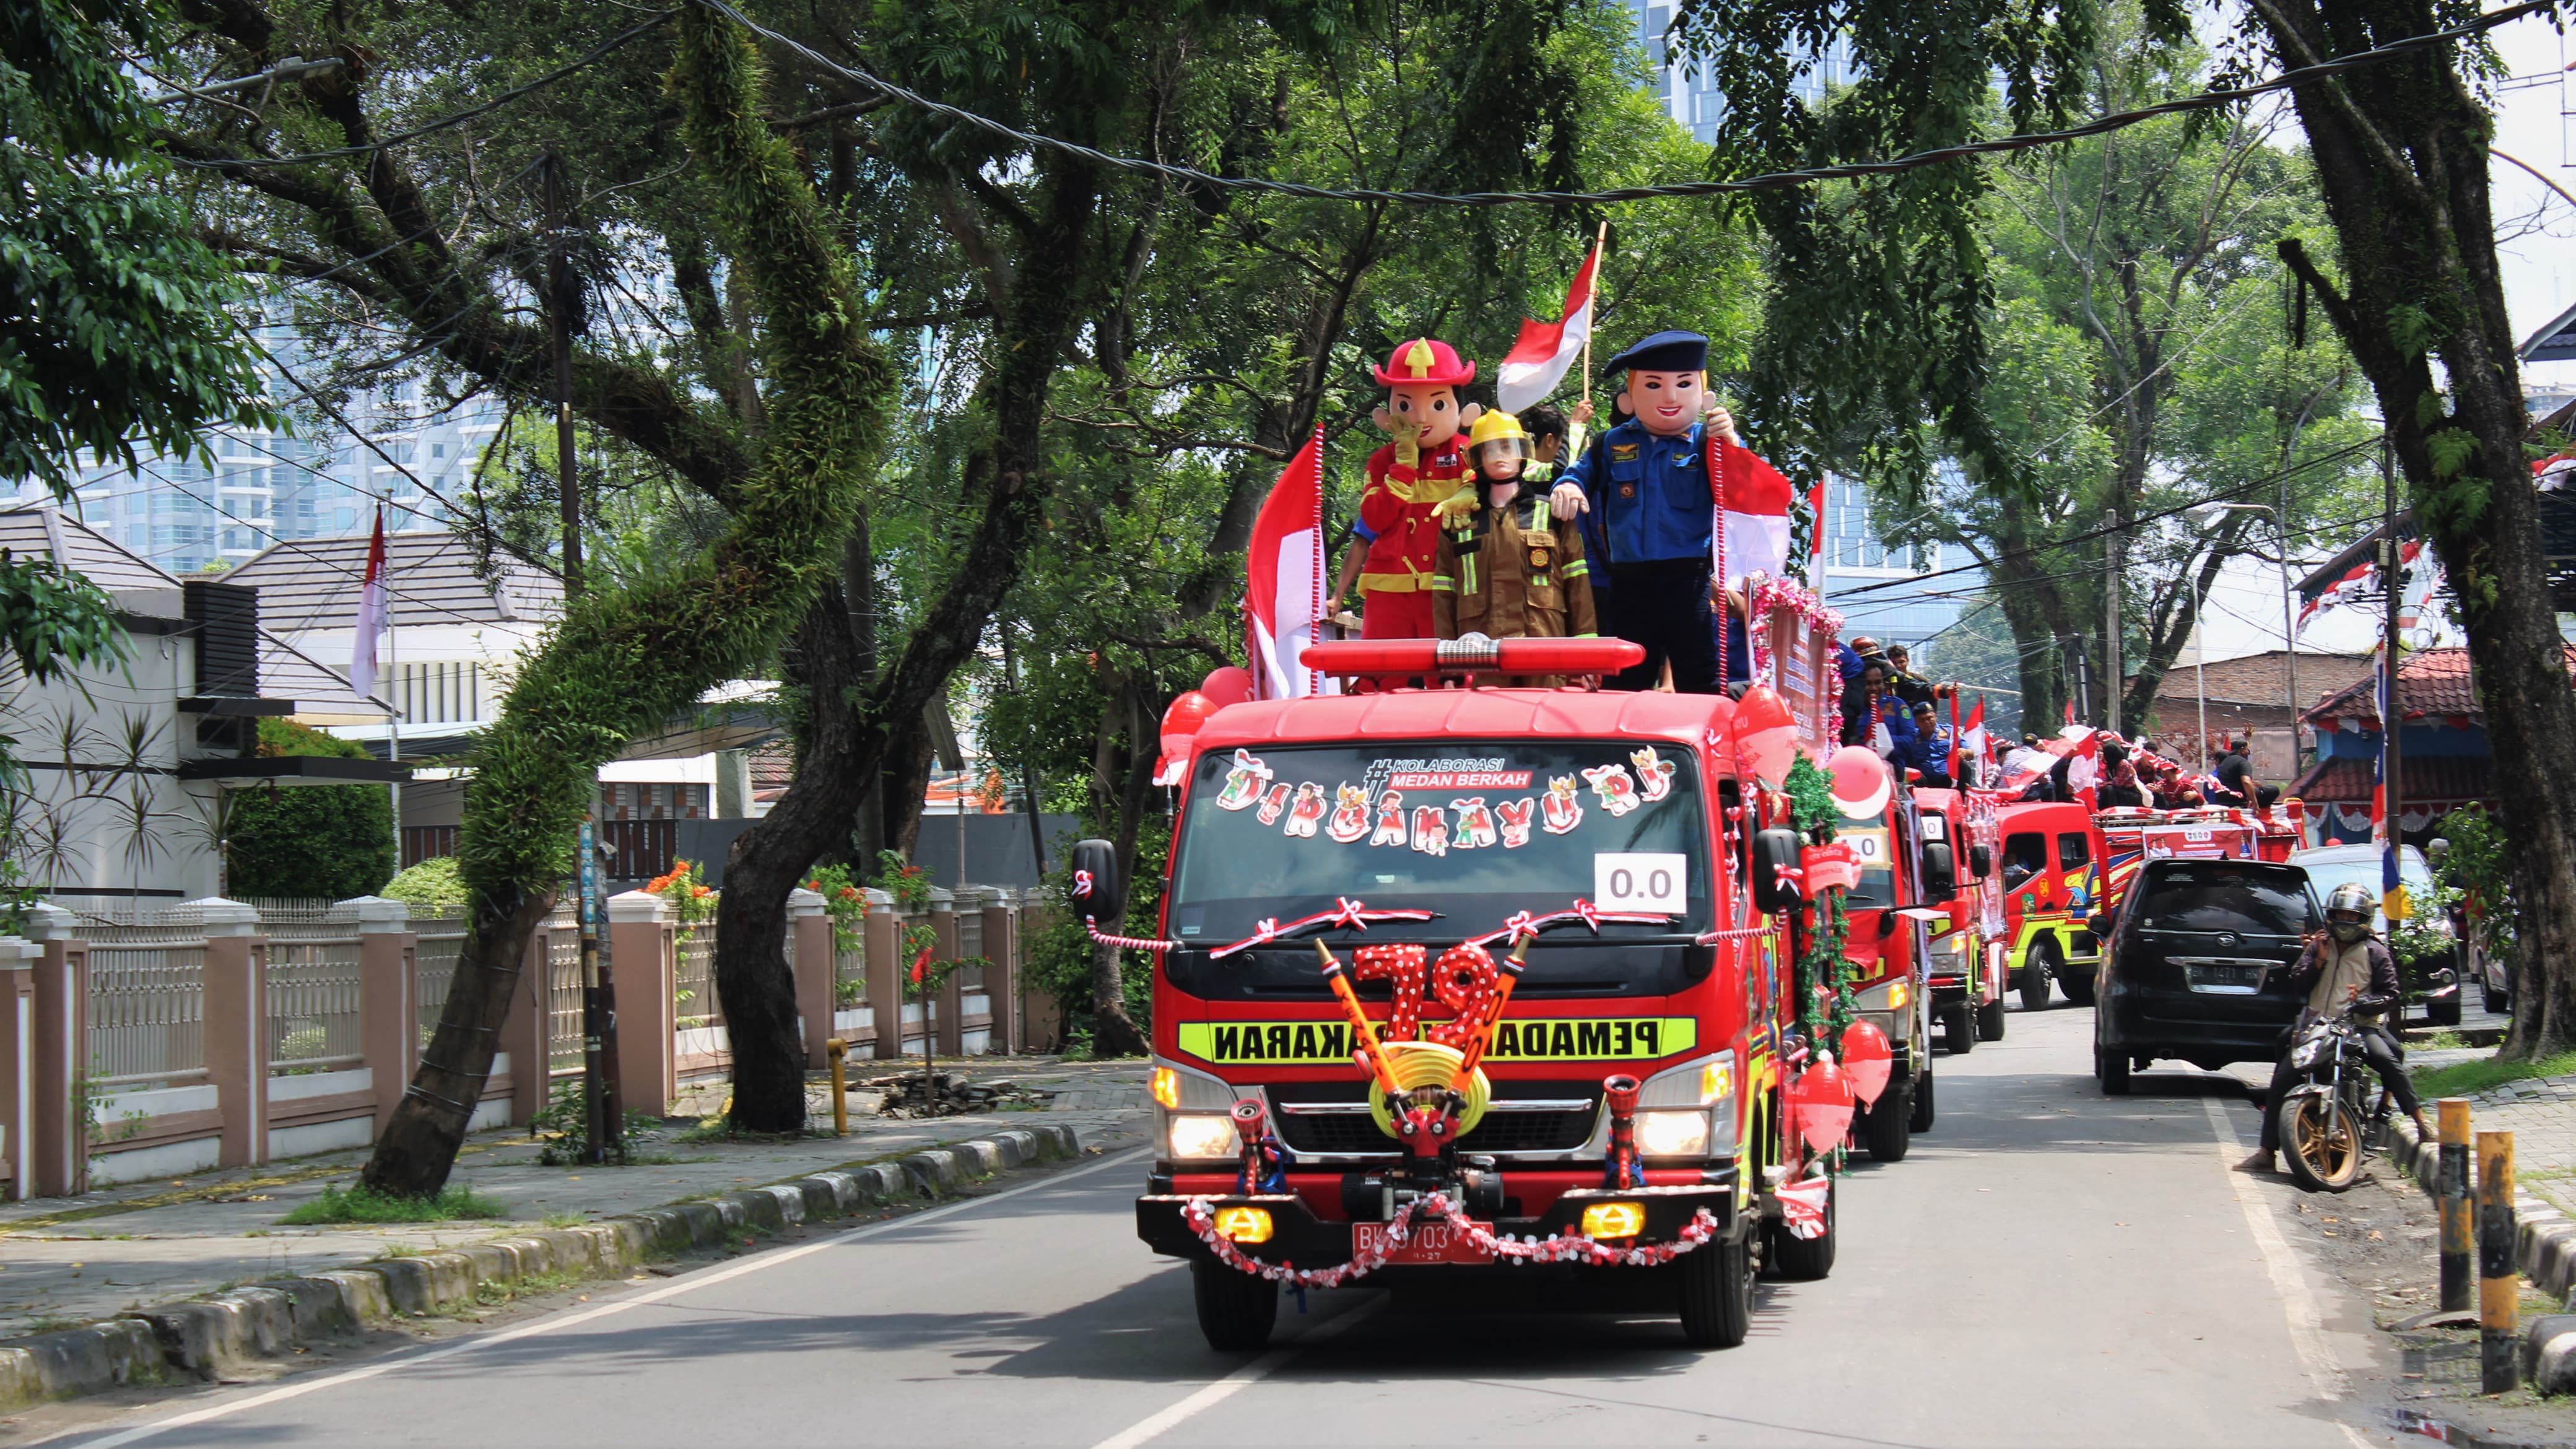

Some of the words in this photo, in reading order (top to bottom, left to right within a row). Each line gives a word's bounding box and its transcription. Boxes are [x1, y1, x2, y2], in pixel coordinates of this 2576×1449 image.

[1391, 775, 1453, 787] MEDAN
[1456, 773, 1528, 786] BERKAH
[1610, 869, 1671, 899] 0.0
[1352, 943, 1498, 1049] 79
